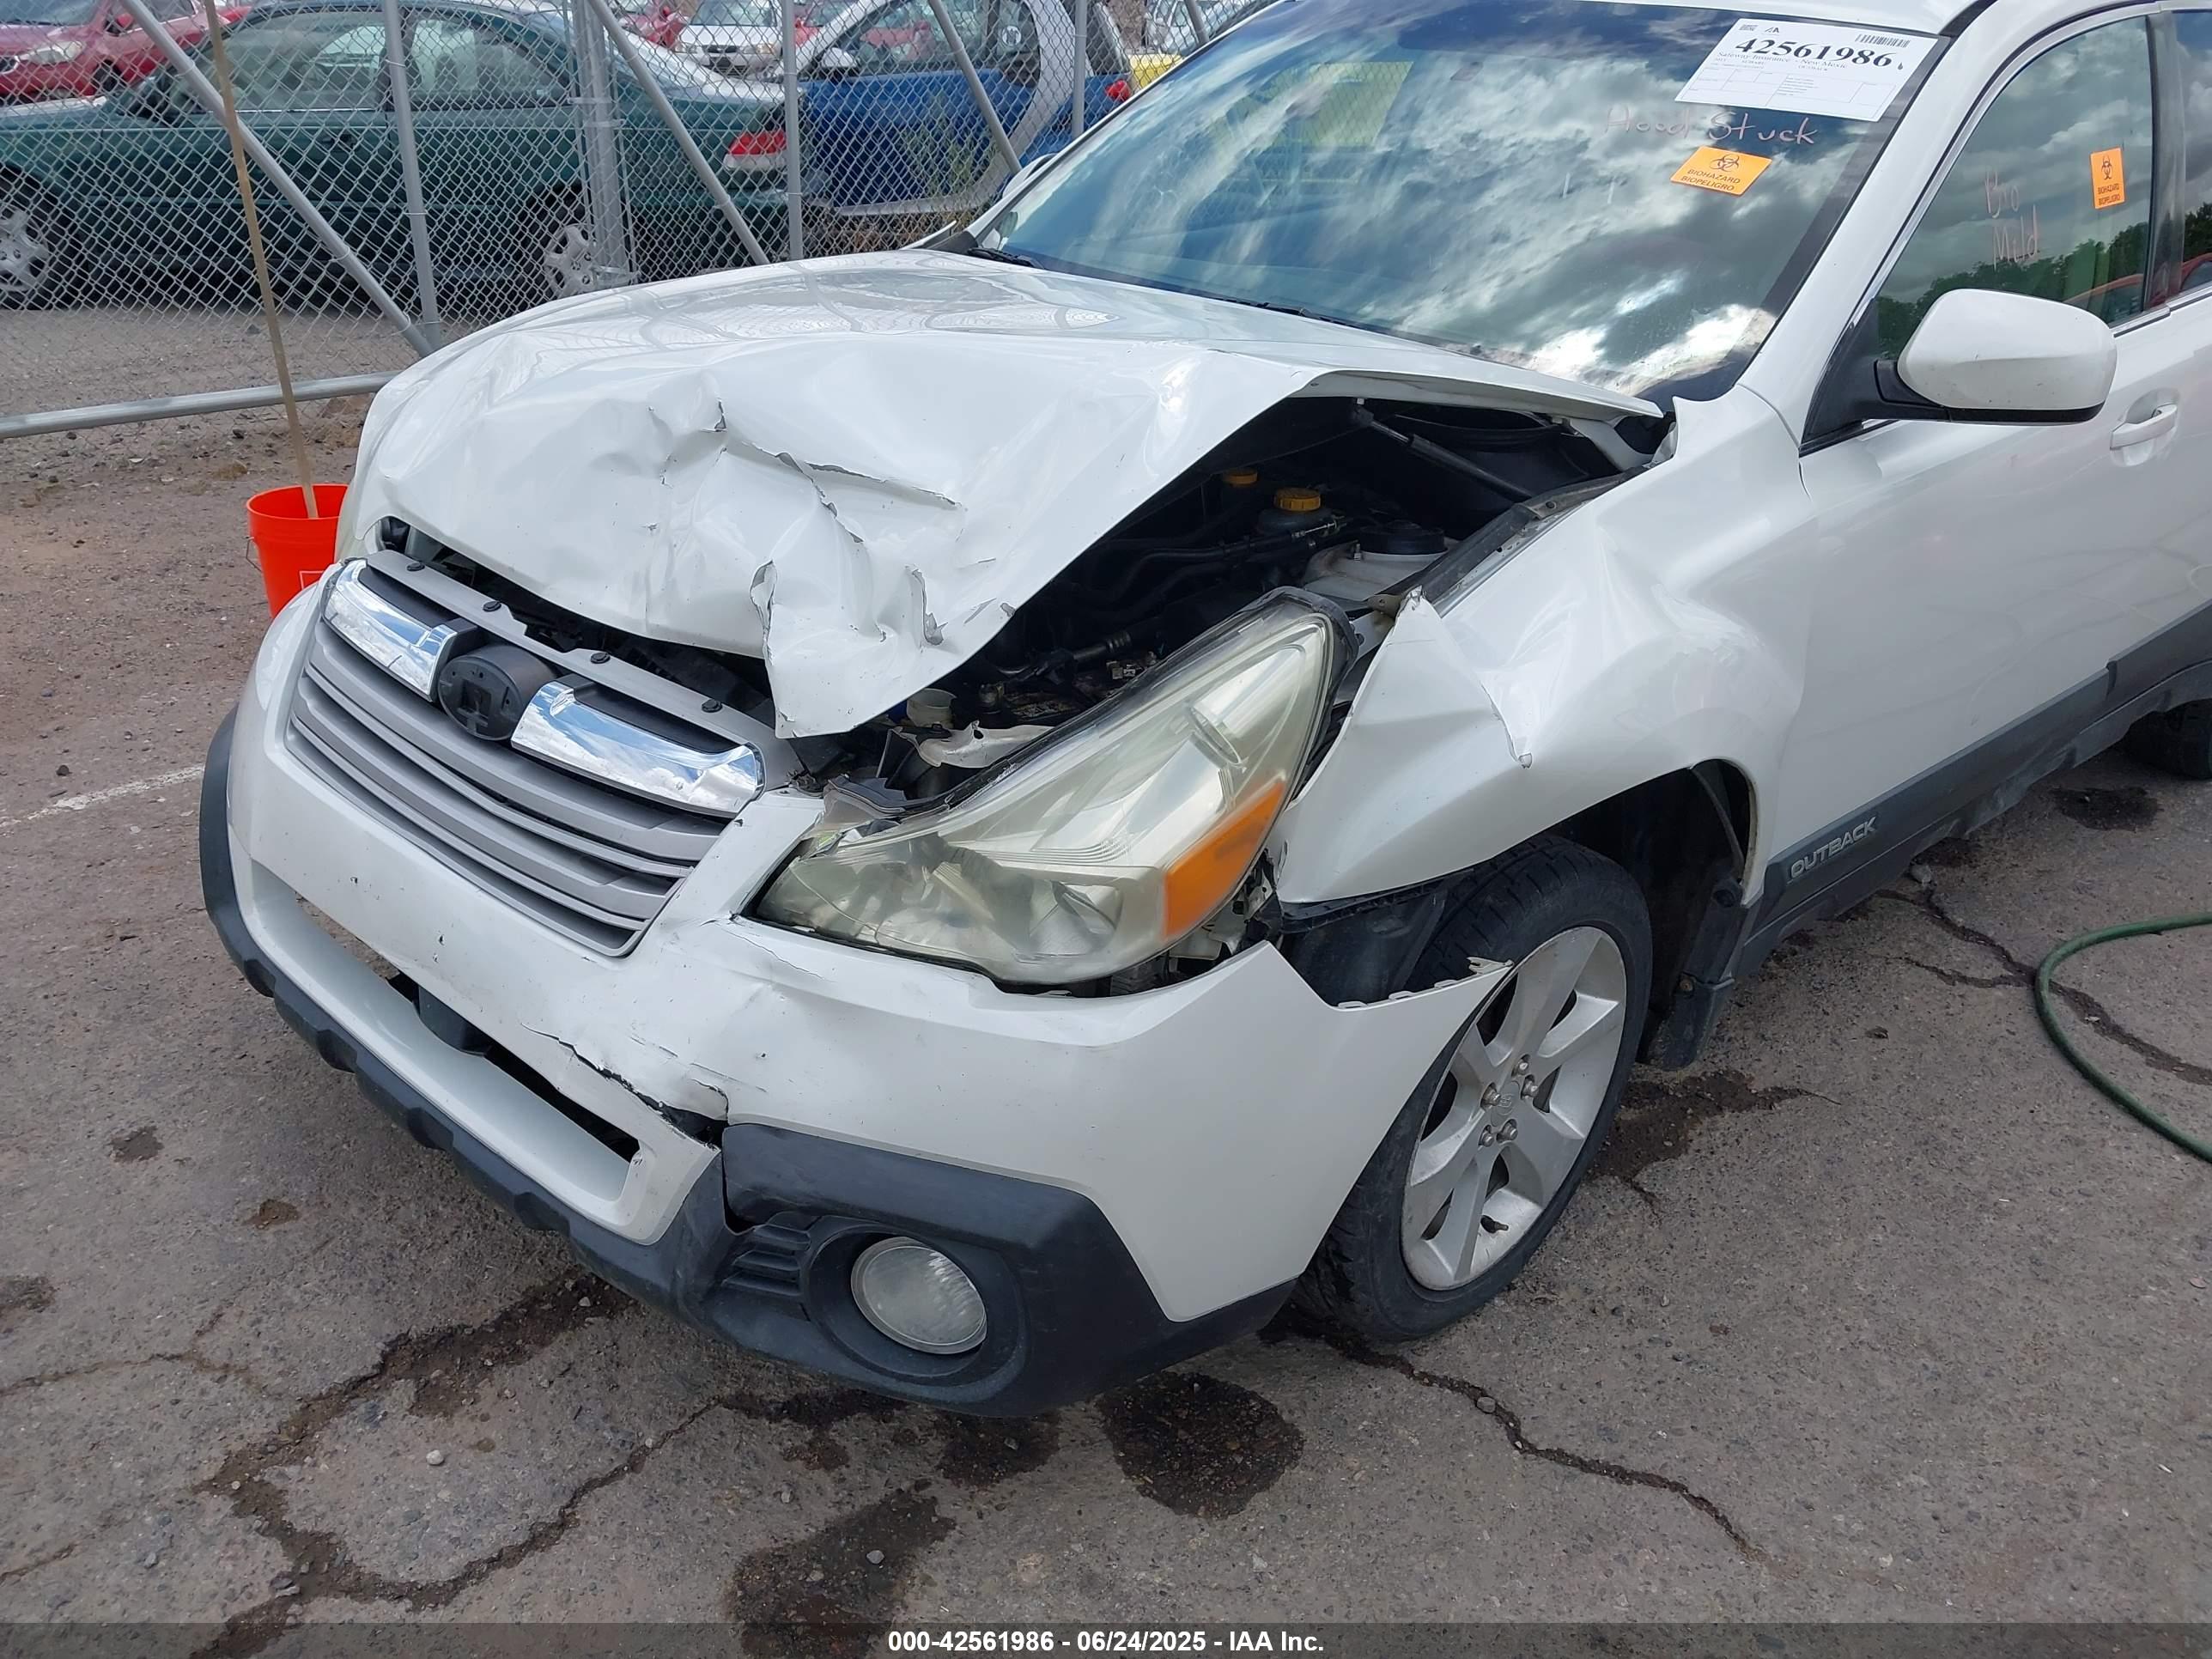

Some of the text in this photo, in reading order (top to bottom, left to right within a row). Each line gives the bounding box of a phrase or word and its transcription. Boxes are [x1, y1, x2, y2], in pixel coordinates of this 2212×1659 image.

[1735, 38, 1896, 67] 42561986
[1680, 175, 1735, 191] BIOPELIGRO
[1686, 168, 1741, 184] BIOHAZARD
[2097, 183, 2120, 195] BIOHAZARD
[1790, 816, 1877, 878] OUTBACK
